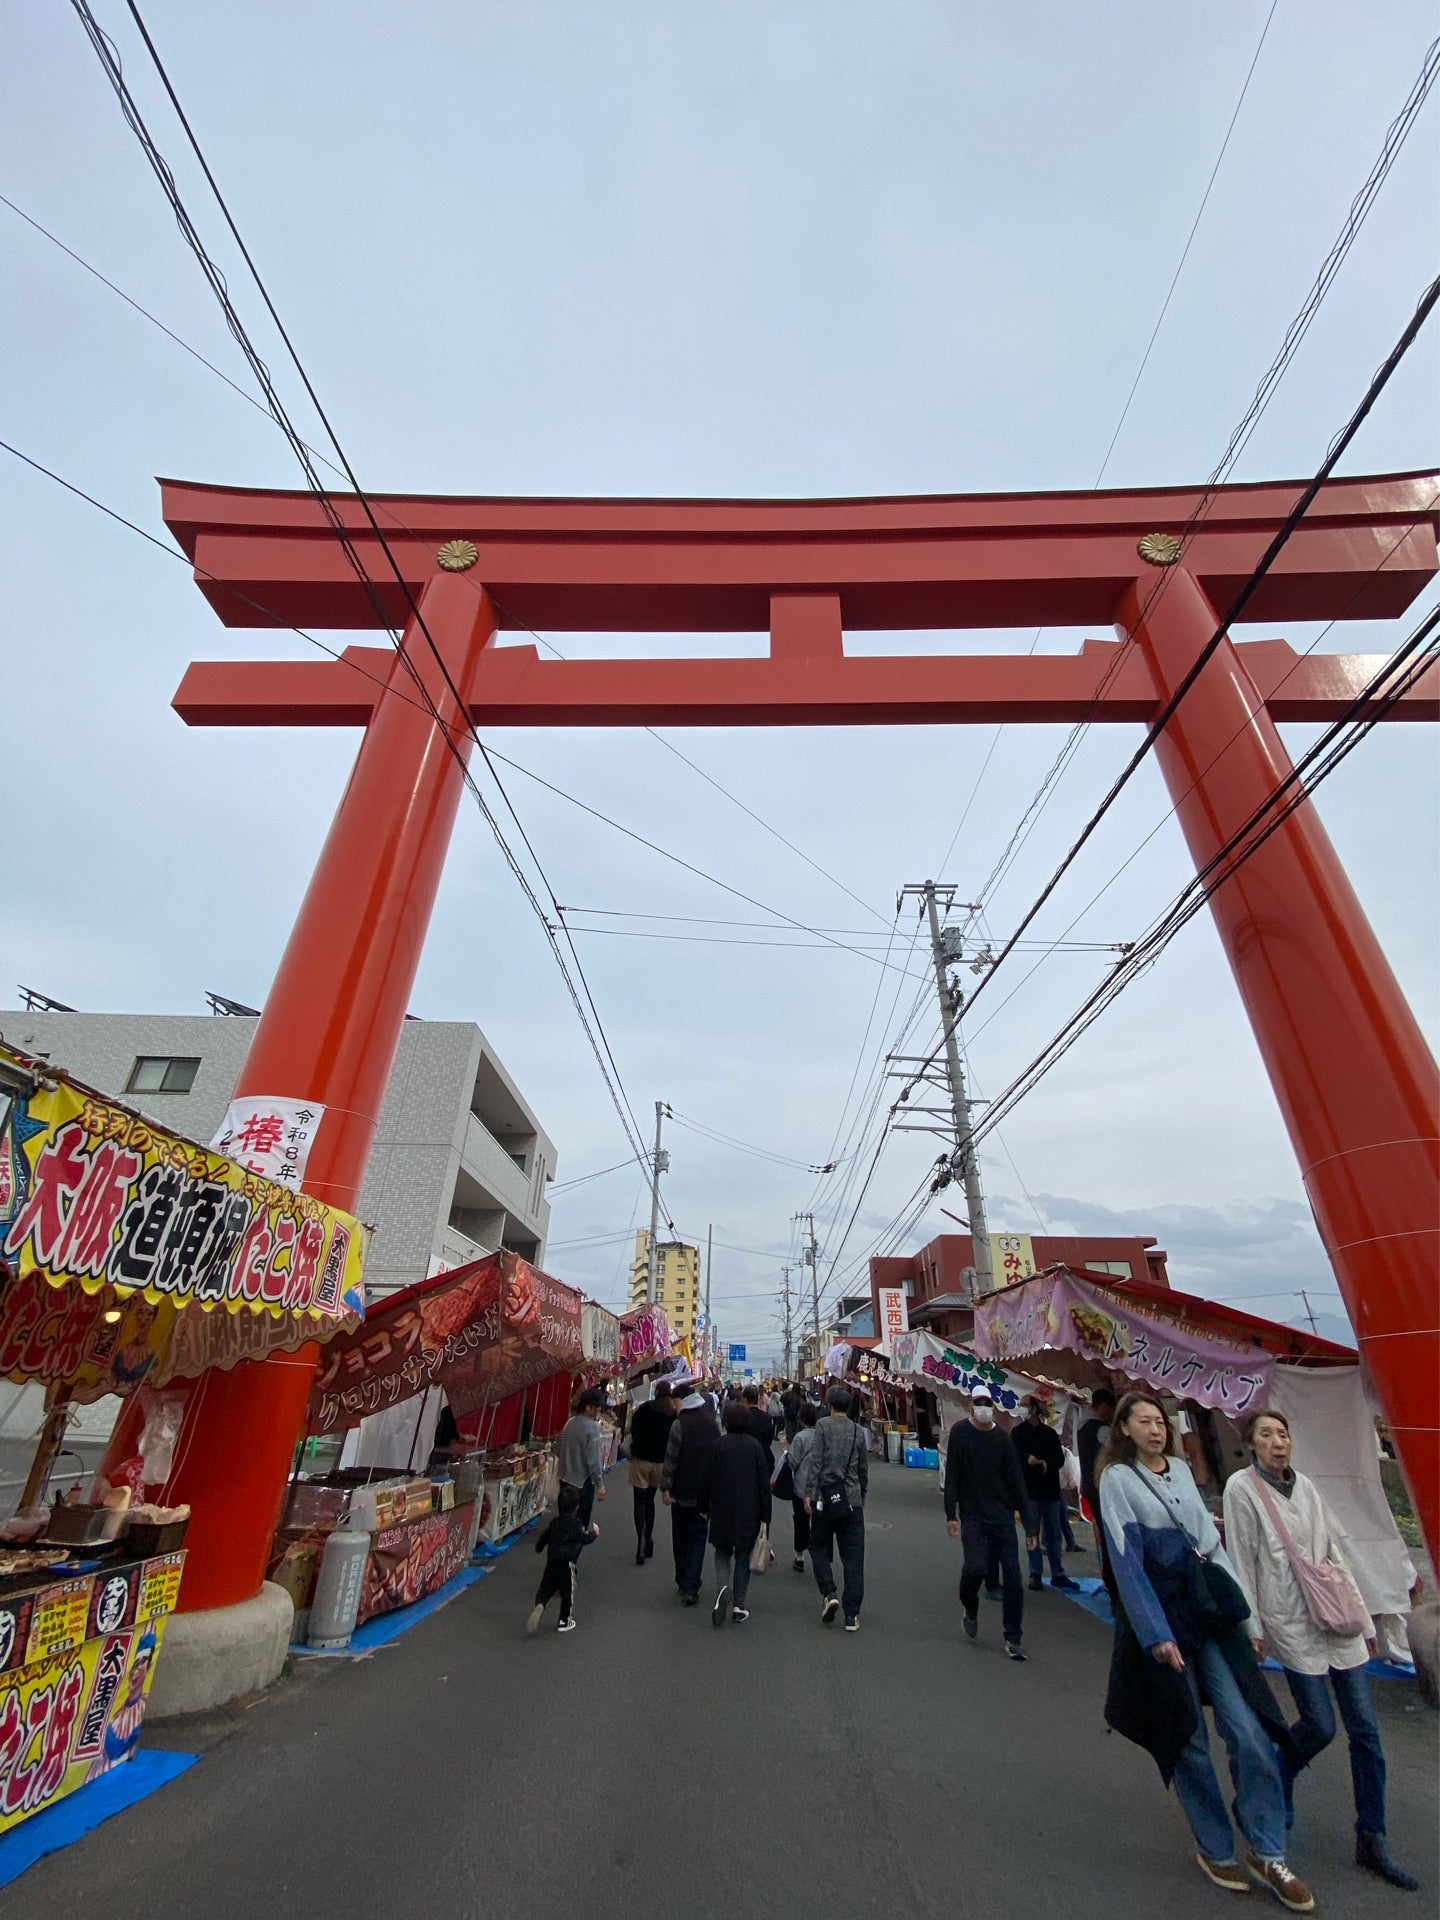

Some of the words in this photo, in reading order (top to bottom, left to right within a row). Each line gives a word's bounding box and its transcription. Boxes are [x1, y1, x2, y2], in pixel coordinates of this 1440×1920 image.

[276, 1109, 314, 1181] 令和8年
[1105, 1321, 1264, 1410] ドネルケバブ
